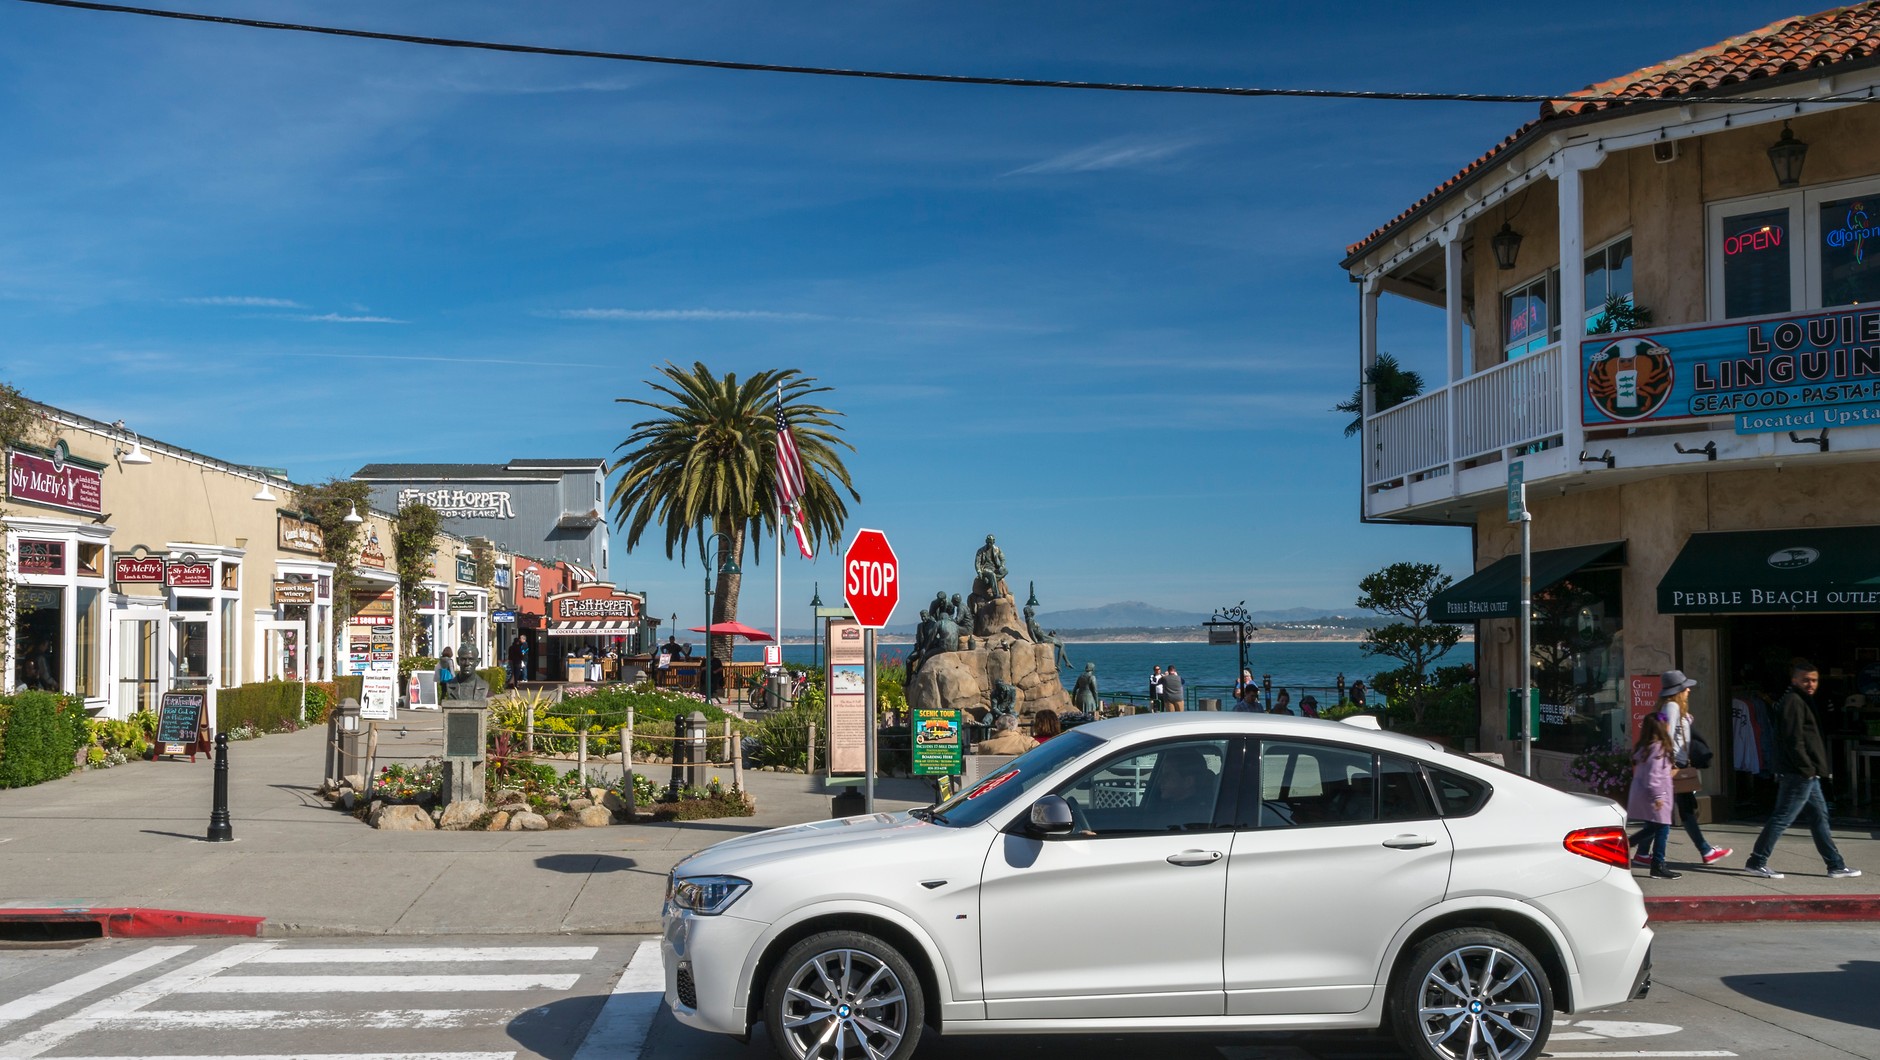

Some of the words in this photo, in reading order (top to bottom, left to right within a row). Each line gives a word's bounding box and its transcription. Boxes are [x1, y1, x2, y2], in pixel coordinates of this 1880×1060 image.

[1724, 227, 1781, 255] OPEN
[1512, 305, 1537, 336] PASA
[1748, 312, 1880, 355] LOUIE
[1694, 345, 1880, 391] LINGUIN
[1693, 390, 1789, 412] SEAFOOD
[1802, 384, 1863, 403] PASTA
[1742, 411, 1815, 430] Located
[12, 467, 29, 492] Sly
[30, 471, 67, 498] McFly's
[452, 490, 515, 518] HOPPER
[118, 564, 131, 573] Sly
[131, 564, 162, 573] McFly's
[848, 560, 895, 597] STOP
[565, 599, 594, 617] FISH
[594, 599, 635, 617] HOPPER
[1447, 602, 1467, 613] PEBBLE
[1469, 601, 1489, 612] BEACH
[1490, 602, 1508, 612] OUTLET
[1673, 591, 1742, 606] PEBBLE
[1751, 589, 1818, 605] BEACH
[1632, 680, 1651, 689] GIFT
[1540, 703, 1558, 714] PEBBLE
[1558, 704, 1576, 716] BEACH
